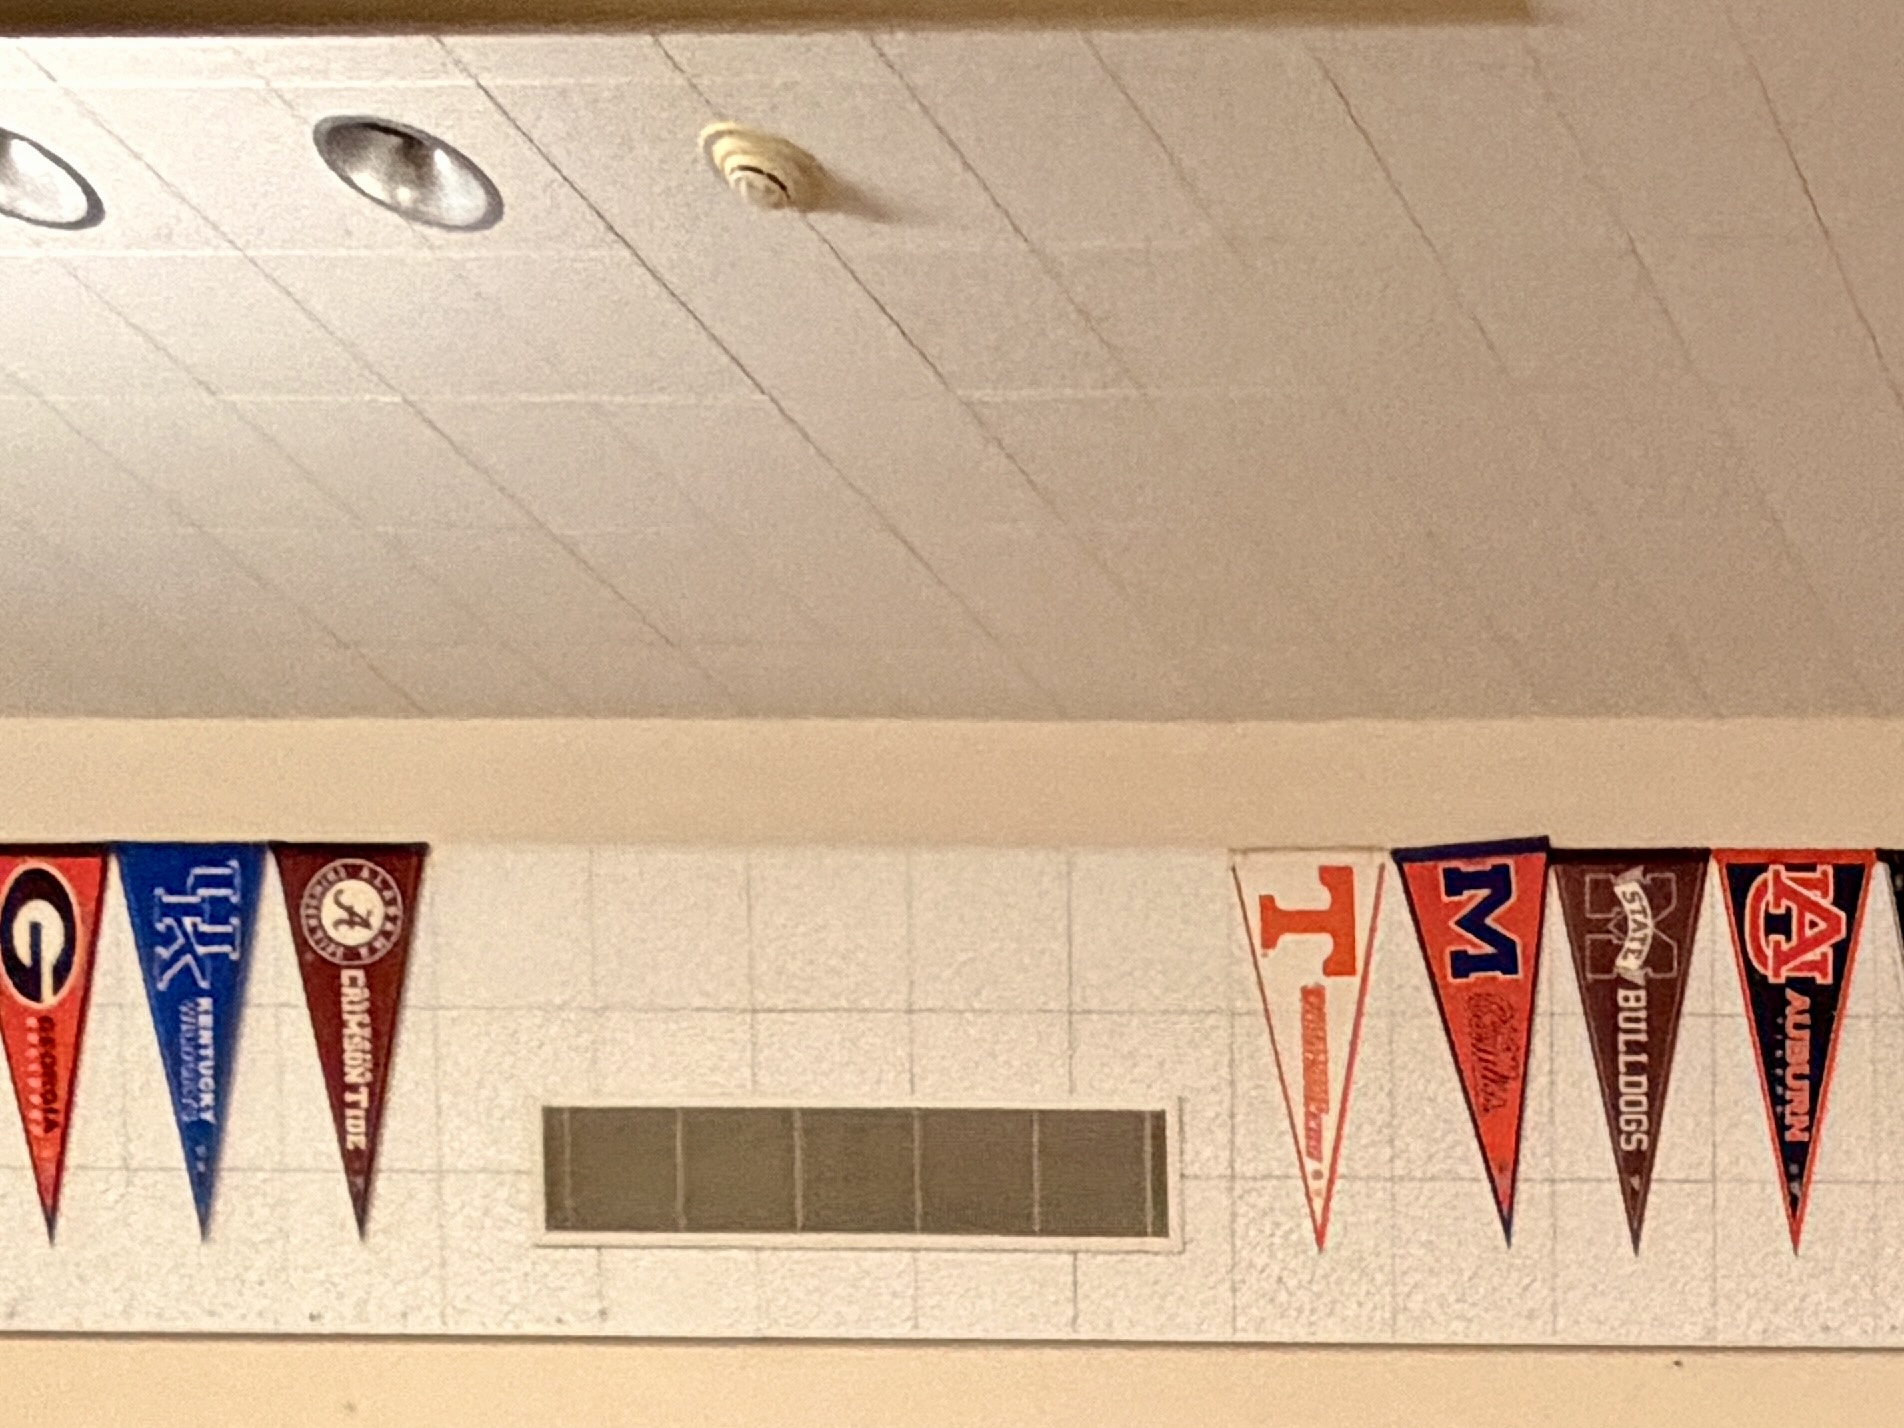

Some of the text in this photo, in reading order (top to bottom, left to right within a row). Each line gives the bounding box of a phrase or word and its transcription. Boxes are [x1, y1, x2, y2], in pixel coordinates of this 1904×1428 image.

[154, 858, 242, 993] UK
[1259, 865, 1357, 977] T
[1438, 861, 1520, 982] M
[1616, 884, 1654, 968] STATE
[196, 996, 216, 1126] KENTUCKY
[340, 967, 374, 1151] CRIMSON TIDE
[1616, 987, 1650, 1153] BULLDOGS
[1782, 987, 1812, 1143] AUBURN
